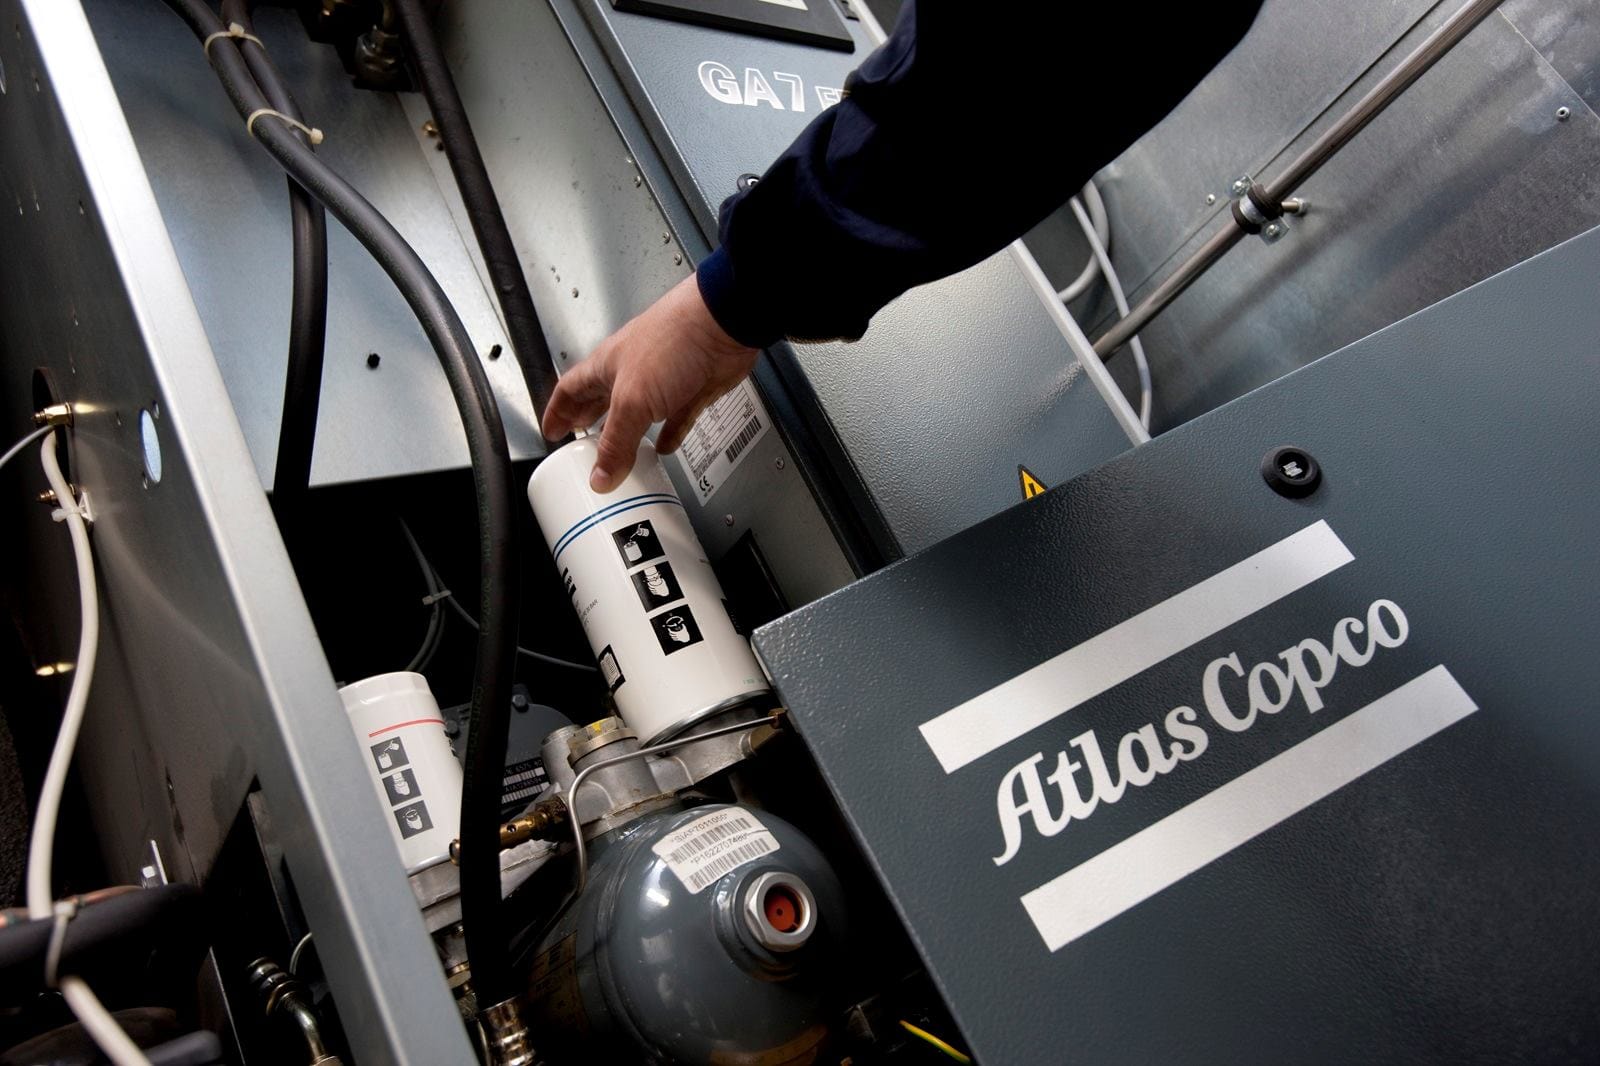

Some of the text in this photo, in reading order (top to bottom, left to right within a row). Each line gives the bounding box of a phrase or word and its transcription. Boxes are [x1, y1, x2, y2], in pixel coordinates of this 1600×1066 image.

[697, 60, 805, 112] GA7
[992, 598, 1409, 866] Atlas Copco
